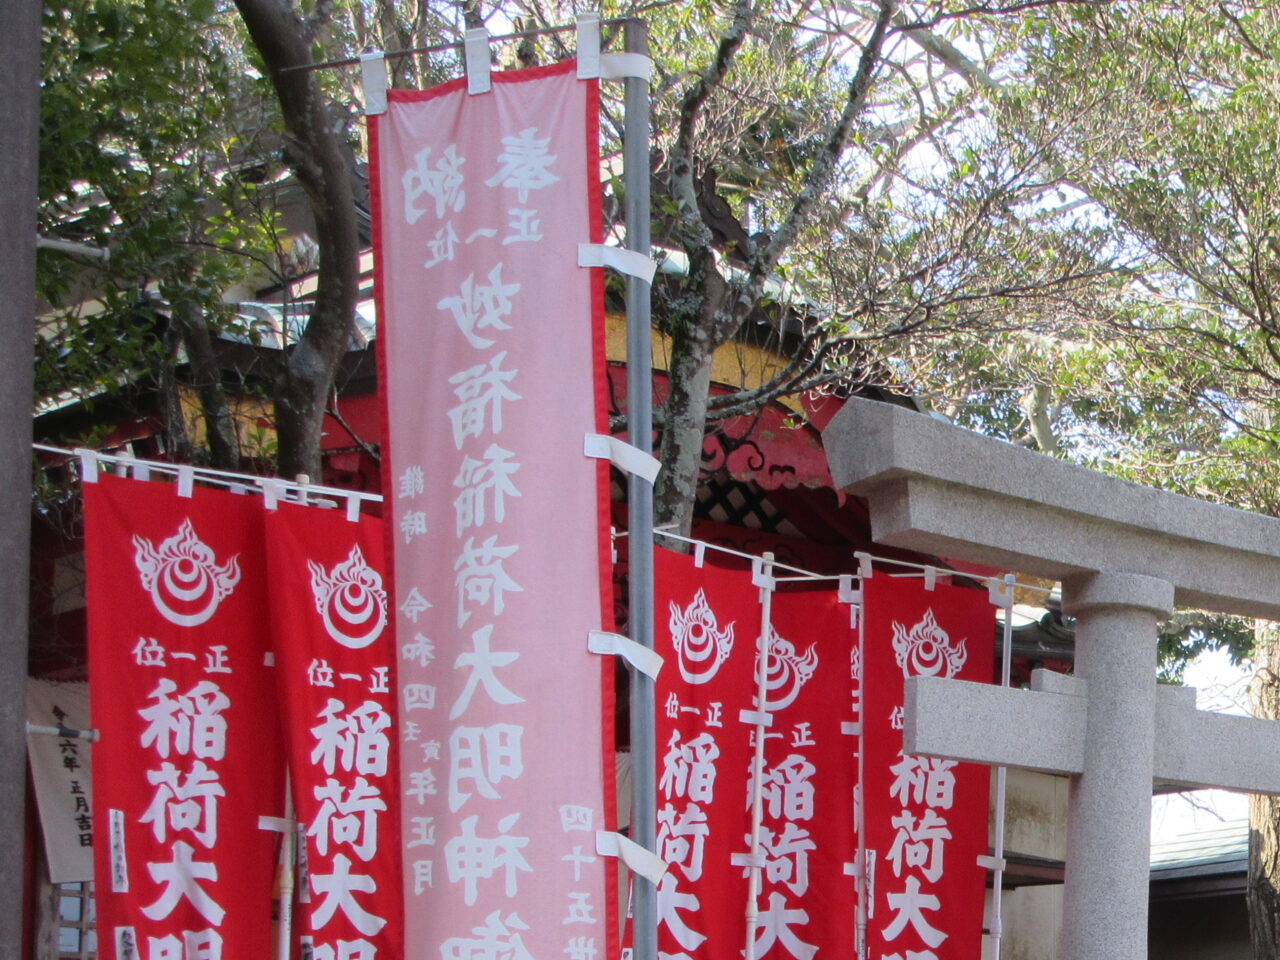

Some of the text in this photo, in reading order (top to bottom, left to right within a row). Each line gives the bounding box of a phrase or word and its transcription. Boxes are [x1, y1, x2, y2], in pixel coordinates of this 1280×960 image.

[132, 636, 233, 675] 正一位
[306, 657, 390, 694] 正一位
[665, 692, 723, 729] 正一位
